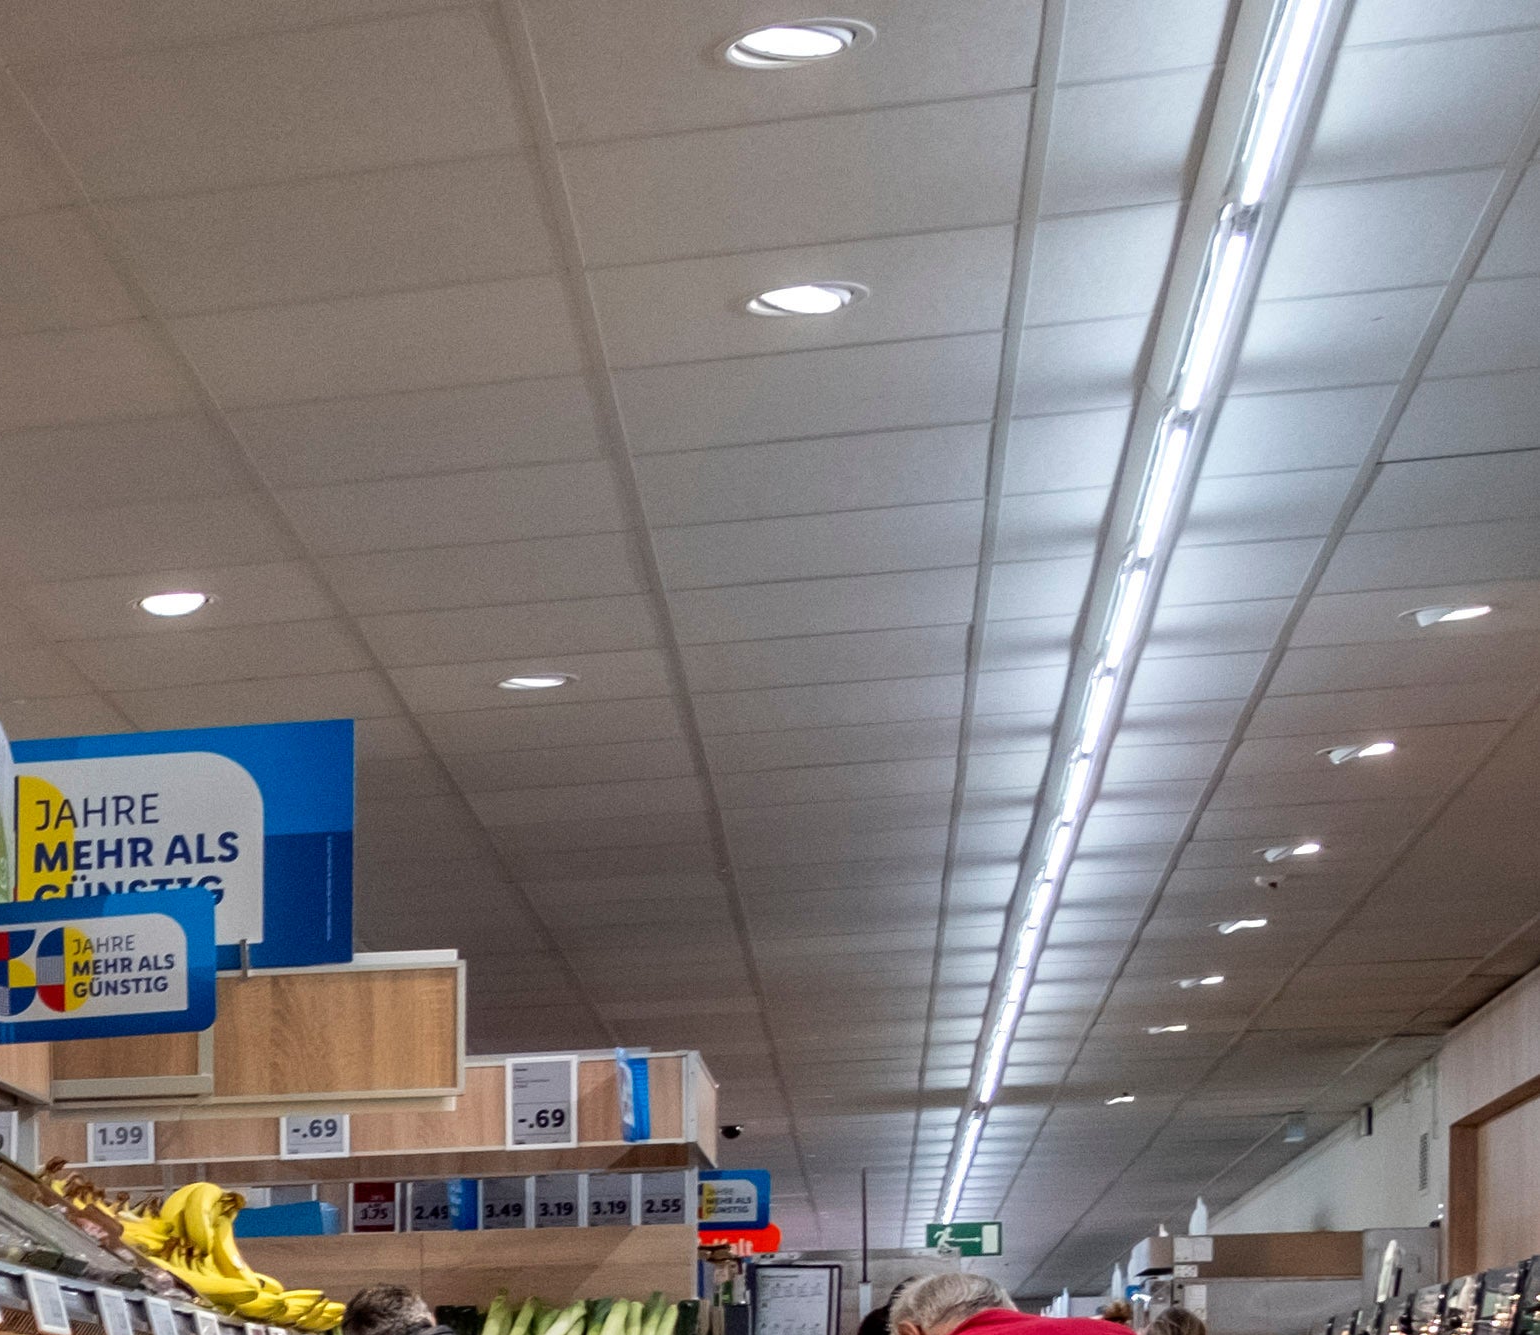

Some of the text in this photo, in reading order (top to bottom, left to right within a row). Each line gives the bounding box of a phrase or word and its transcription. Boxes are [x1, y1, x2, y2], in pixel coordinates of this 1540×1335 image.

[34, 793, 160, 831] JAHRE
[33, 830, 240, 873] MEHR ALS
[72, 935, 136, 956] JAHRE
[72, 953, 175, 977] MEHR ALS
[72, 976, 169, 999] GÜNSTIG
[292, 1118, 338, 1138] -.69
[518, 1108, 566, 1129] -.69
[98, 1126, 144, 1146] 1.99
[414, 1205, 449, 1220] 2.49
[485, 1203, 524, 1218] 3.49
[539, 1202, 574, 1217] 3.19
[591, 1200, 627, 1216] 3.19
[645, 1198, 681, 1214] 2.55
